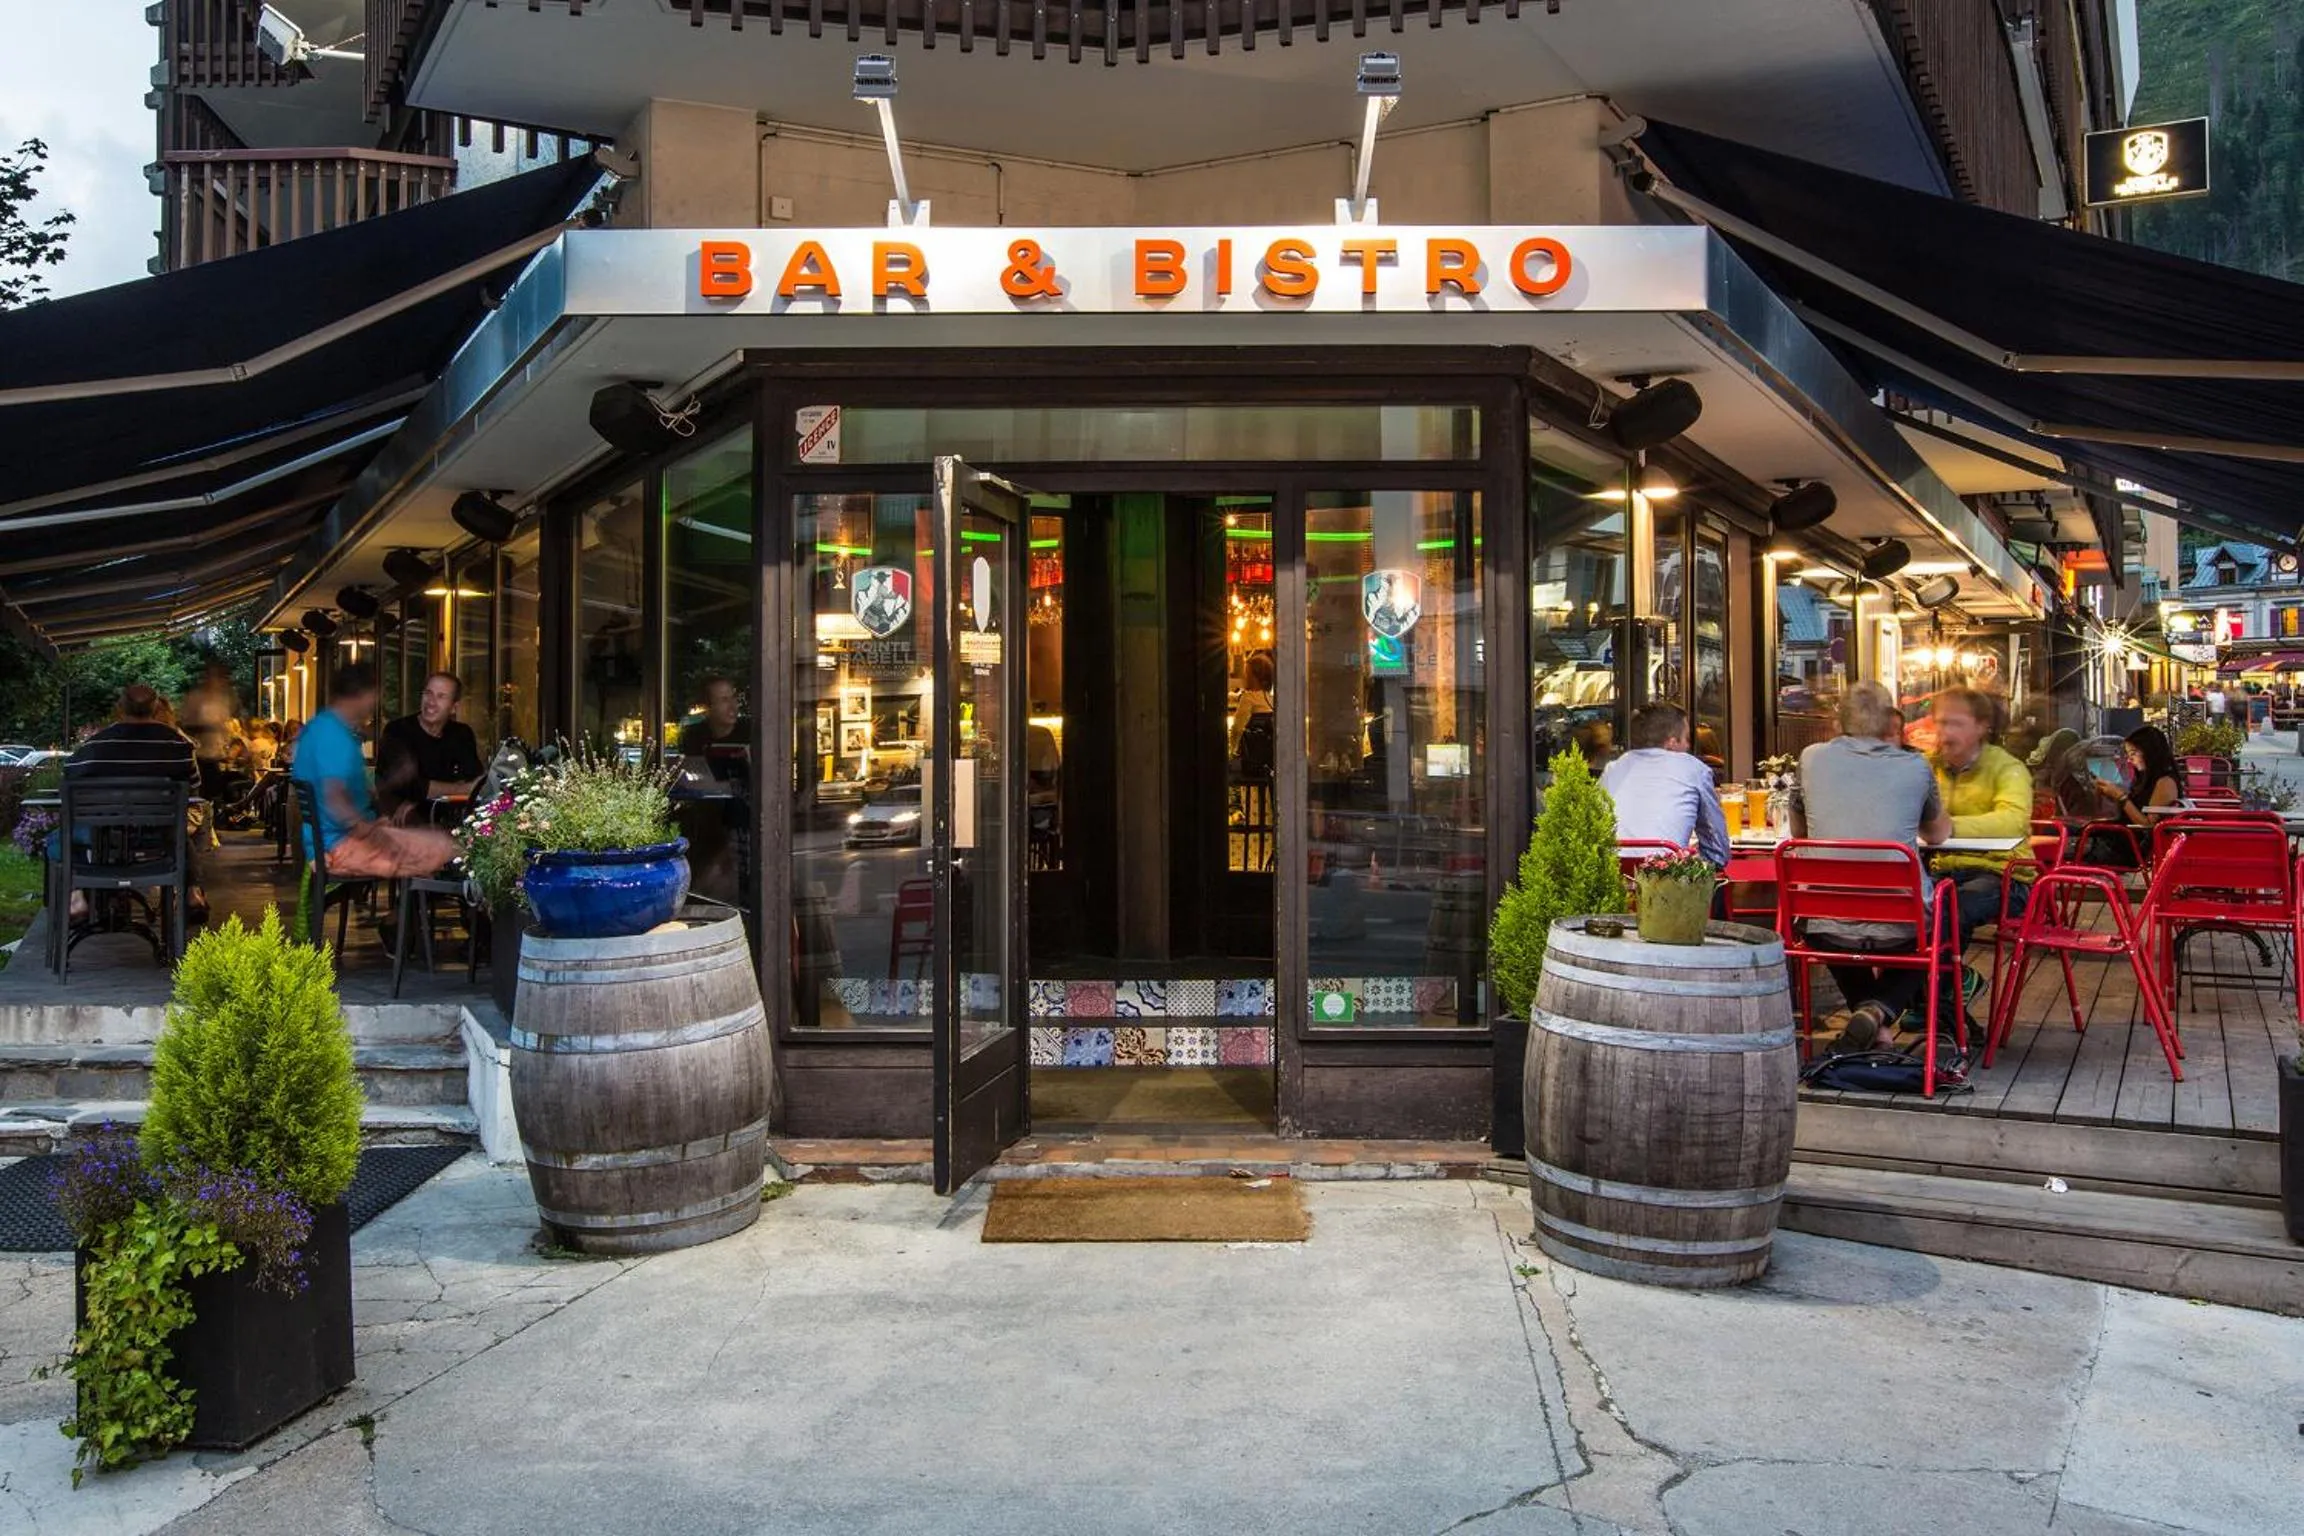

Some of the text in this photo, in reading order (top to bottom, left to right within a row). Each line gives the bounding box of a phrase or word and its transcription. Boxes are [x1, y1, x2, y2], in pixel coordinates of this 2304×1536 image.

[700, 237, 1573, 297] BAR & BISTRO
[799, 407, 838, 459] LICENCE
[827, 440, 836, 450] IV
